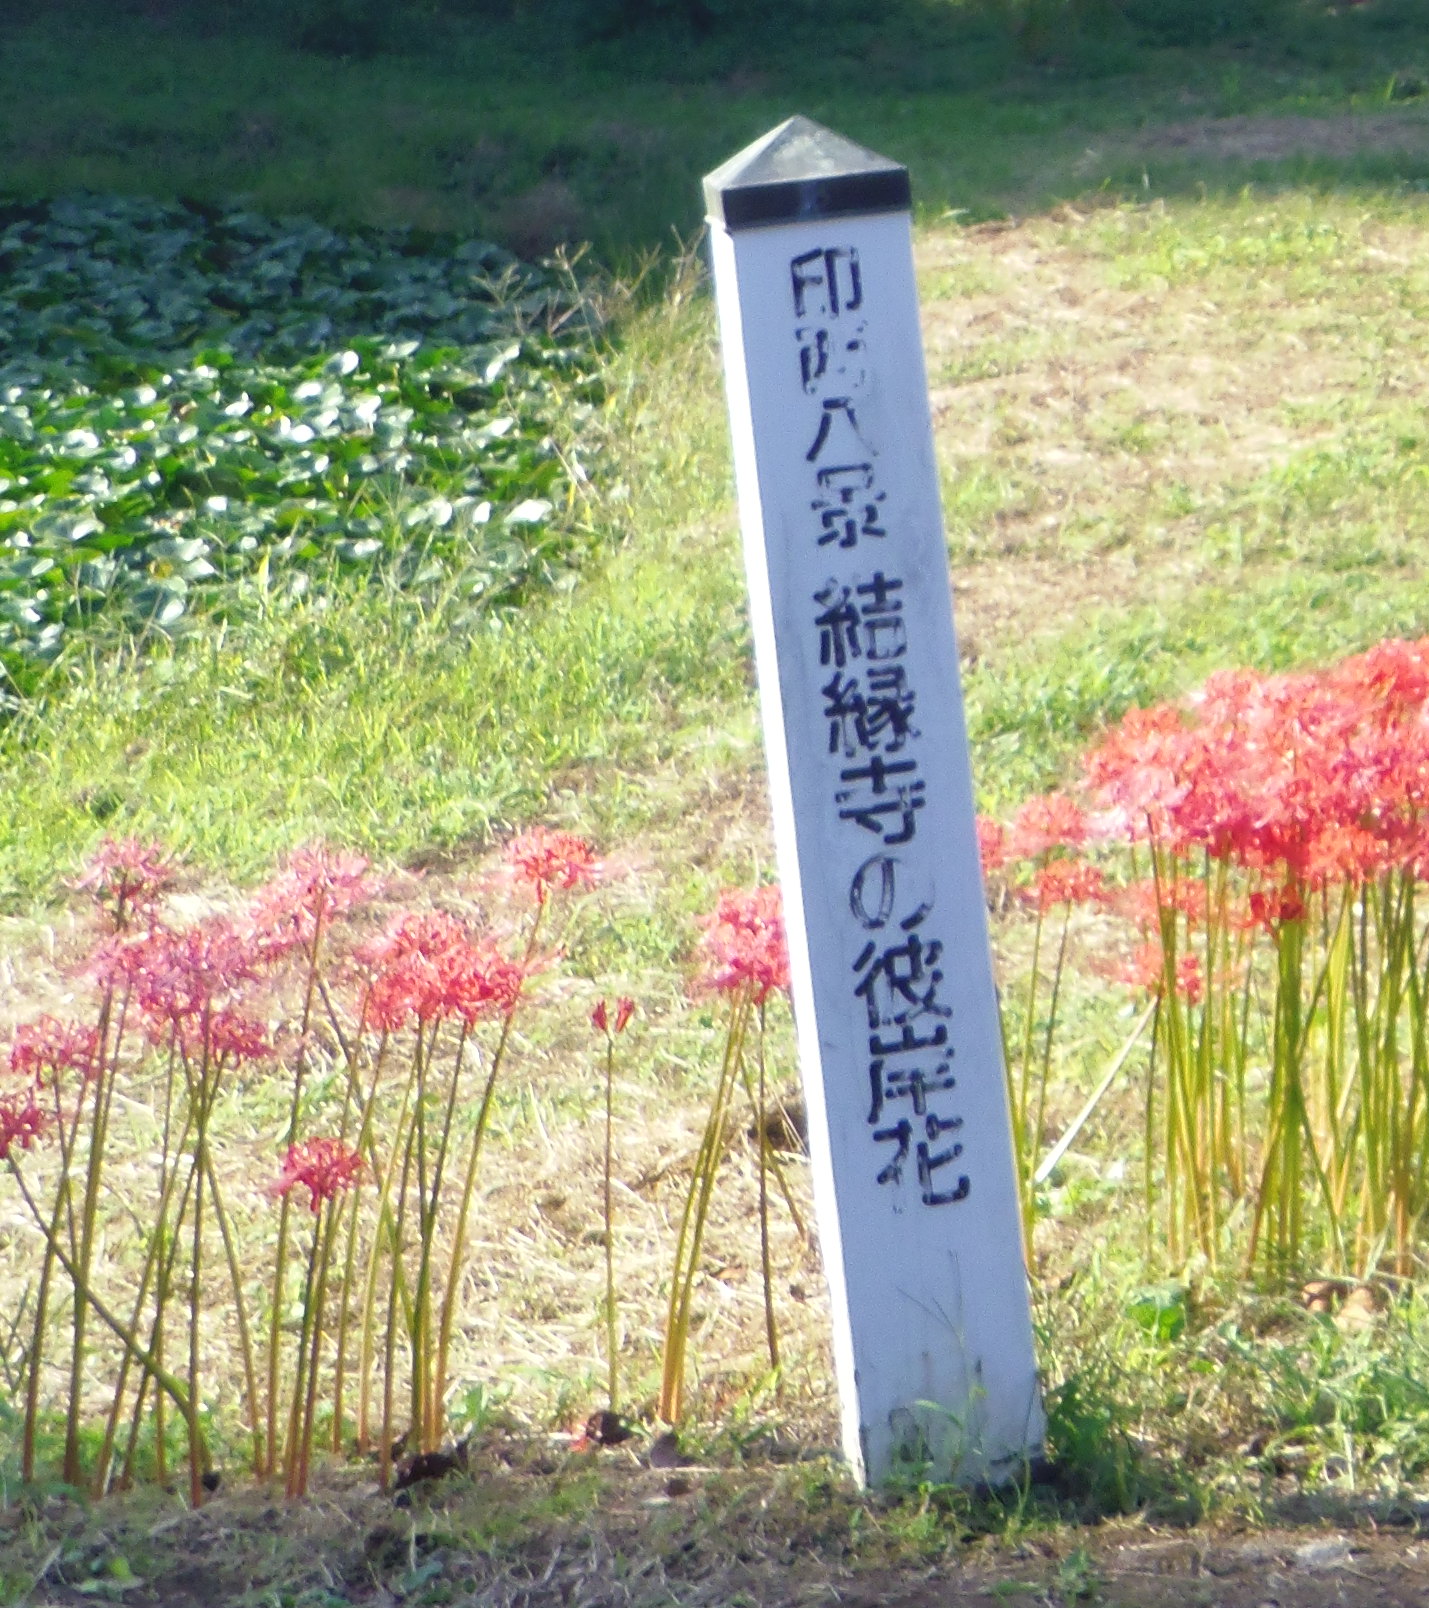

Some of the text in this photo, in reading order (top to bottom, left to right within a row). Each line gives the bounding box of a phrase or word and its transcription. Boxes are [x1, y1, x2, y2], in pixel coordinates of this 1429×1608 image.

[813, 571, 970, 1209] 結縁寺の彼岸花
